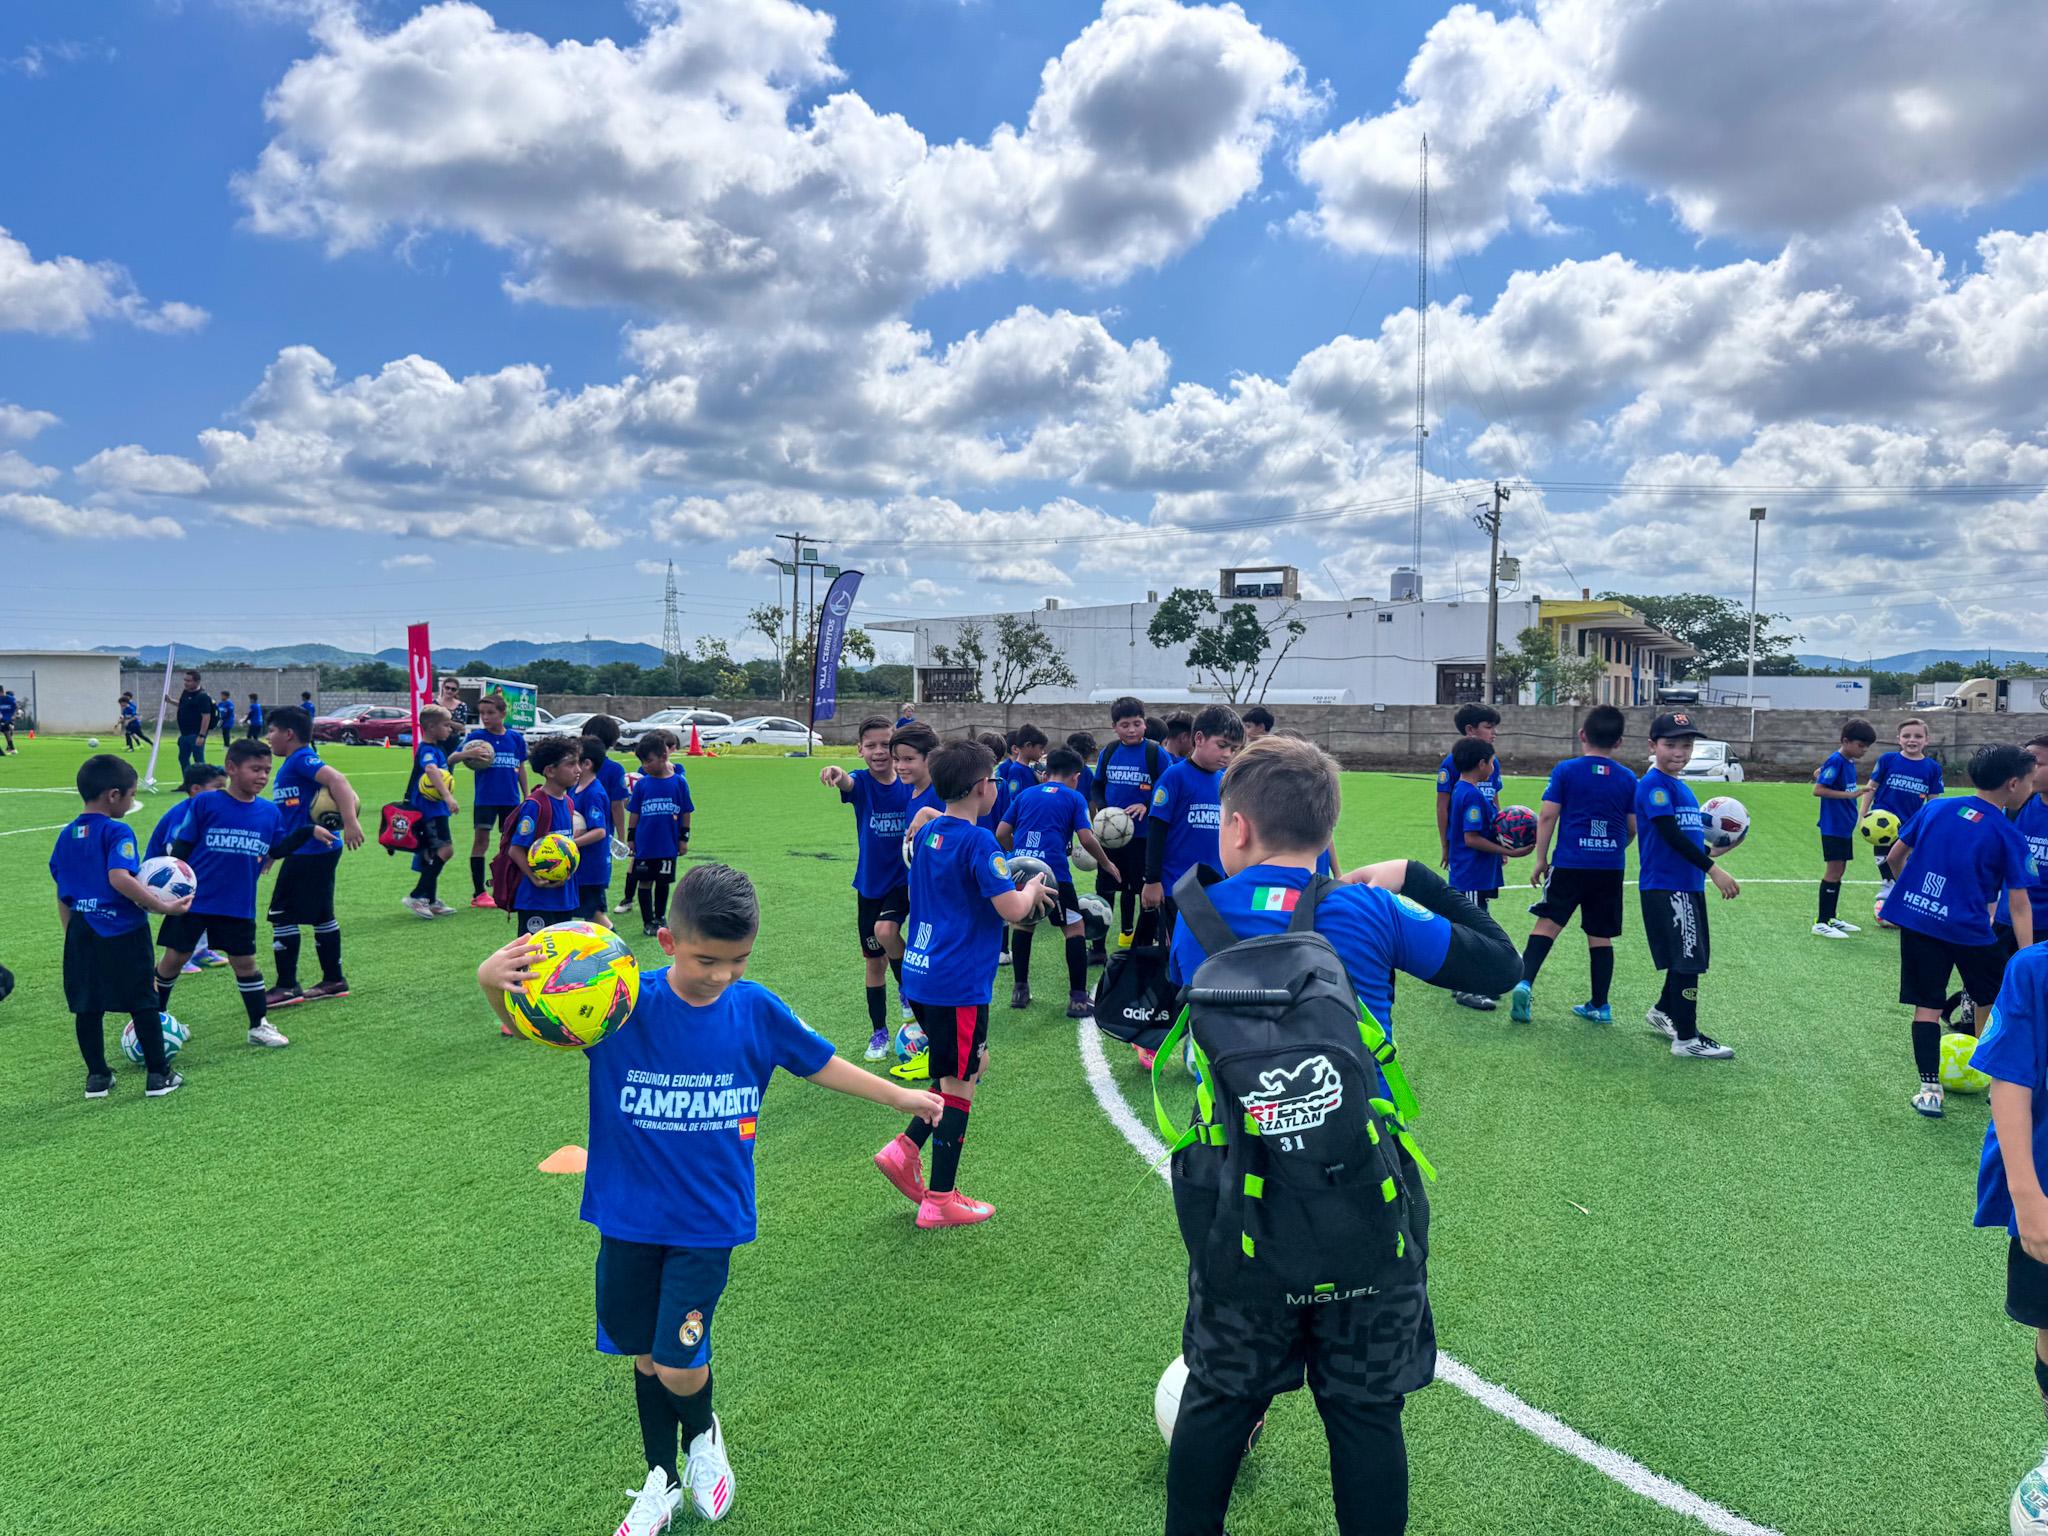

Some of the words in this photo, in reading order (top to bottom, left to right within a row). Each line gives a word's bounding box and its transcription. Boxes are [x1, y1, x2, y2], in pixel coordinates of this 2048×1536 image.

[822, 618, 835, 663] CERRITOS
[819, 665, 828, 690] VILLA
[1187, 811, 1220, 824] CAMPA
[1579, 837, 1618, 848] HERSA
[1014, 848, 1046, 859] HERSA
[659, 860, 672, 874] 11
[1903, 890, 1948, 917] HERSA
[543, 935, 558, 959] Voit
[626, 1069, 670, 1087] SEGUNDA
[671, 1072, 713, 1087] EDICIÓN
[619, 1085, 760, 1119] CAMPAMENTO
[632, 1118, 687, 1132] INTERNACIONAL
[689, 1121, 698, 1132] DE
[699, 1119, 724, 1131] FÚTBOL
[724, 1118, 738, 1129] BASE
[1258, 1111, 1321, 1132] AZATLAN
[1279, 1134, 1306, 1152] 31
[1285, 1285, 1381, 1305] MIGUEL
